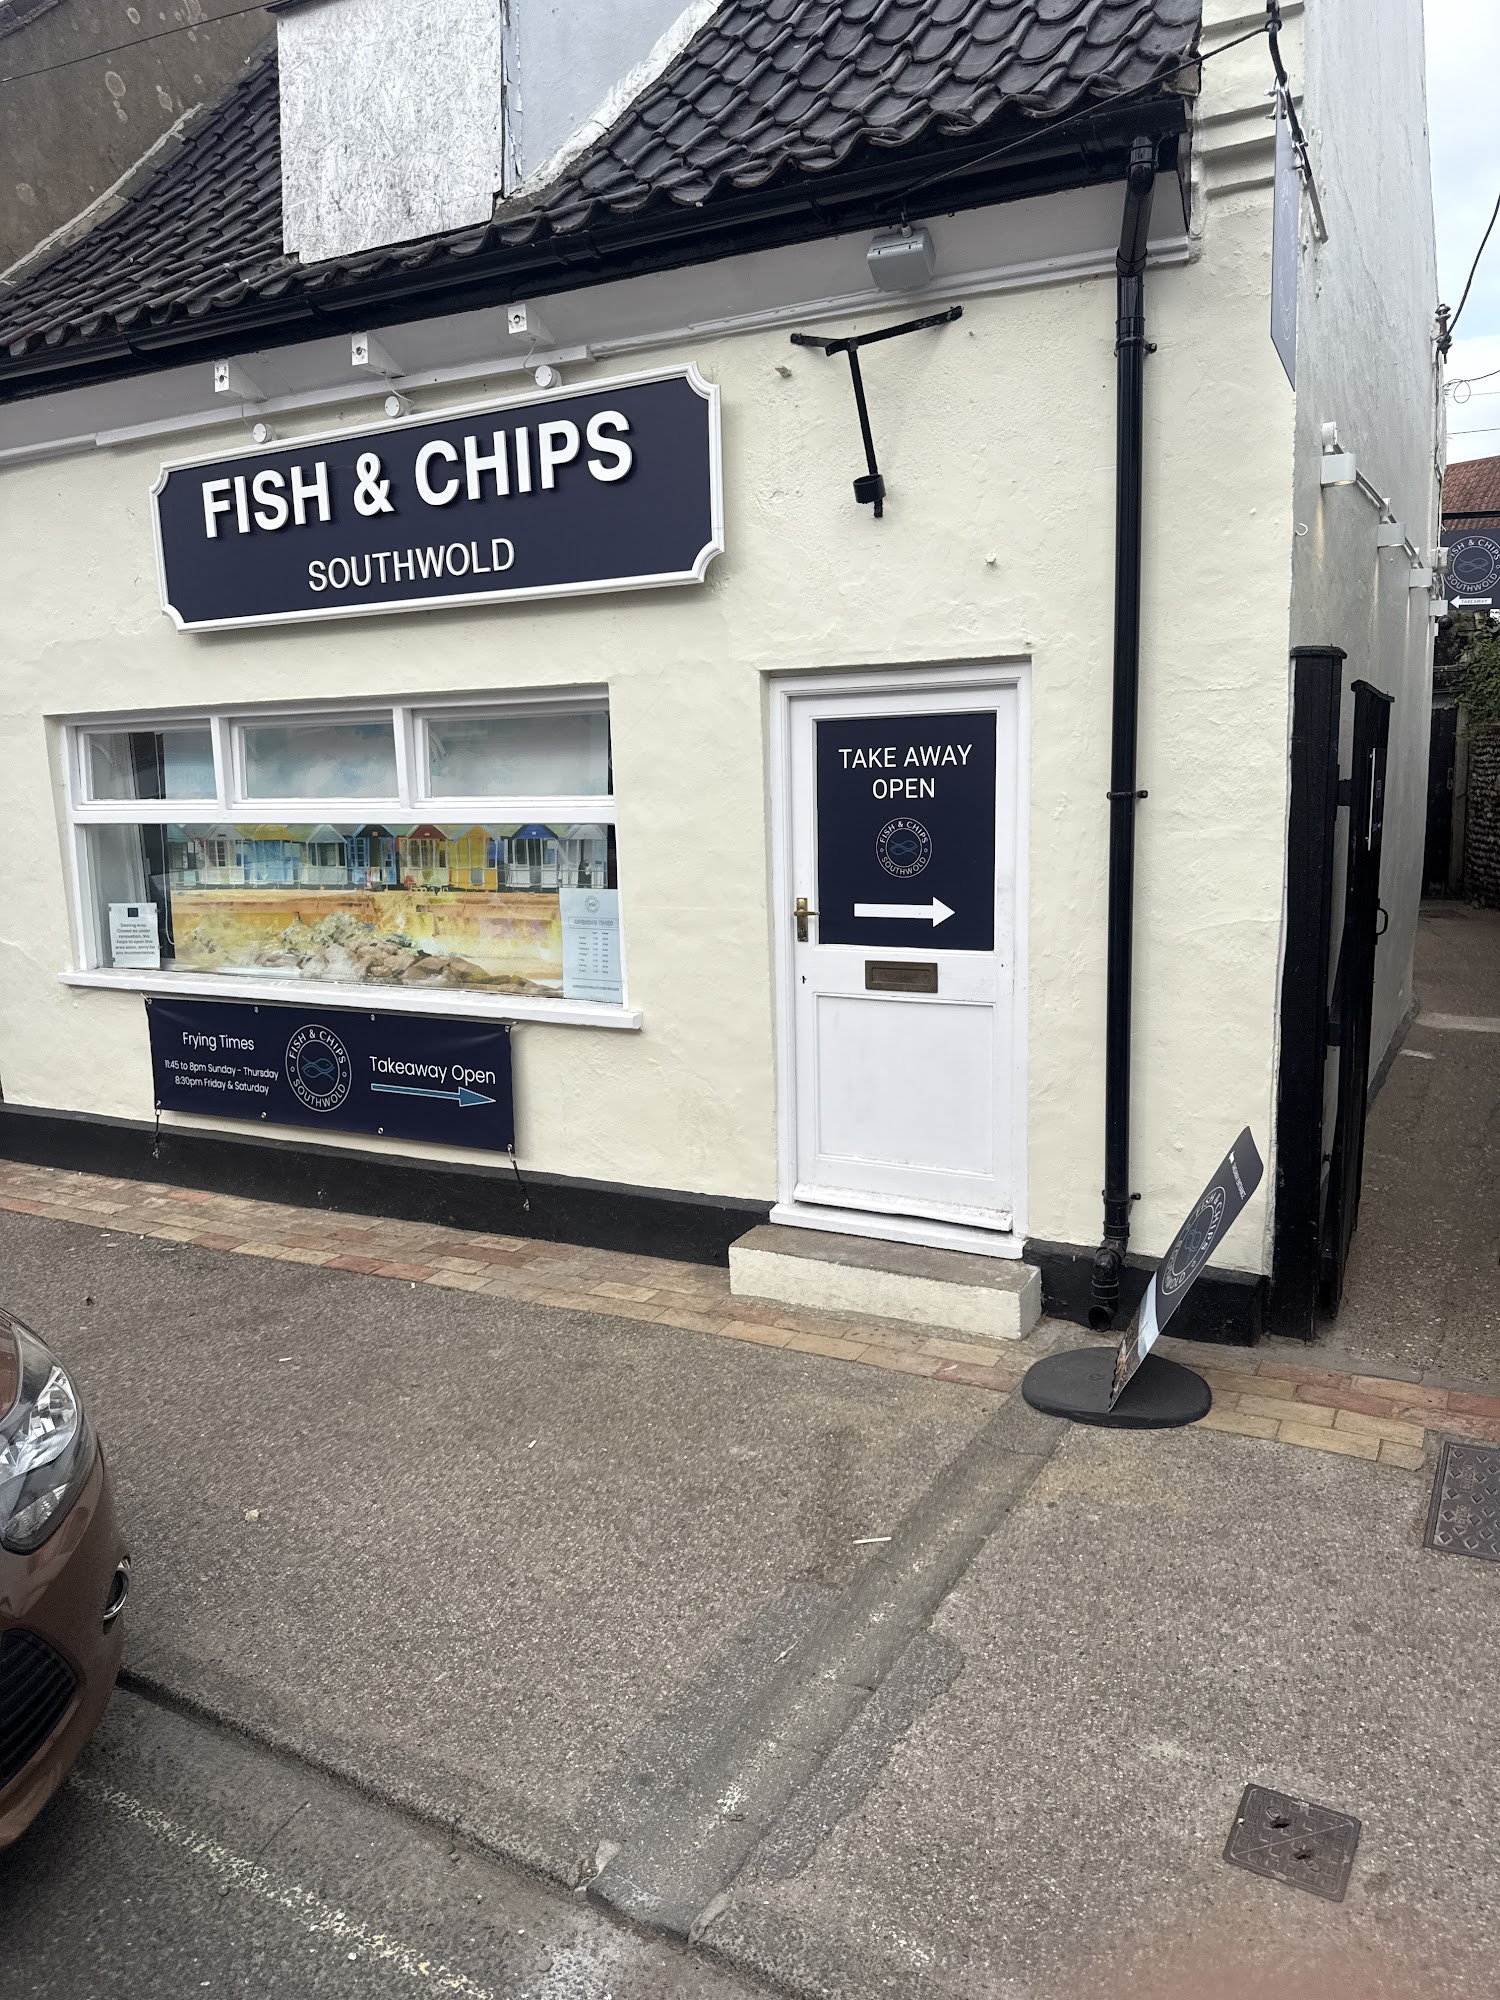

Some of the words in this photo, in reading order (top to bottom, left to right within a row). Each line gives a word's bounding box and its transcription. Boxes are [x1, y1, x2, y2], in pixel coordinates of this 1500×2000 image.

[201, 461, 331, 538] FISH
[353, 452, 394, 516] &
[414, 411, 633, 506] CHIPS
[1478, 539, 1500, 561] CHIPS
[308, 537, 515, 591] SOUTHWOLD
[1447, 573, 1498, 592] SOUTHWOLD
[838, 747, 897, 769] TAKE
[904, 744, 973, 767] AWAY
[872, 778, 935, 800] OPEN
[880, 824, 895, 843] FISH
[906, 821, 928, 843] CHIPS
[882, 857, 926, 875] SOUTHWOLD
[182, 1032, 217, 1052] Frying
[218, 1034, 255, 1051] Times
[289, 1032, 307, 1060] FISH
[309, 1028, 316, 1039] &
[319, 1031, 347, 1064] CHIPS
[180, 1061, 188, 1070] to
[189, 1062, 207, 1073] 8pm
[208, 1063, 236, 1077] Sunday
[242, 1066, 279, 1081] Thursday
[369, 1056, 447, 1084] Takeaway
[451, 1064, 496, 1087] Open
[174, 1076, 203, 1088] 8:30pm
[204, 1078, 226, 1091] Friday
[228, 1080, 234, 1090] &
[235, 1081, 269, 1095] Saturday
[293, 1078, 346, 1107] SOUTHWOLD
